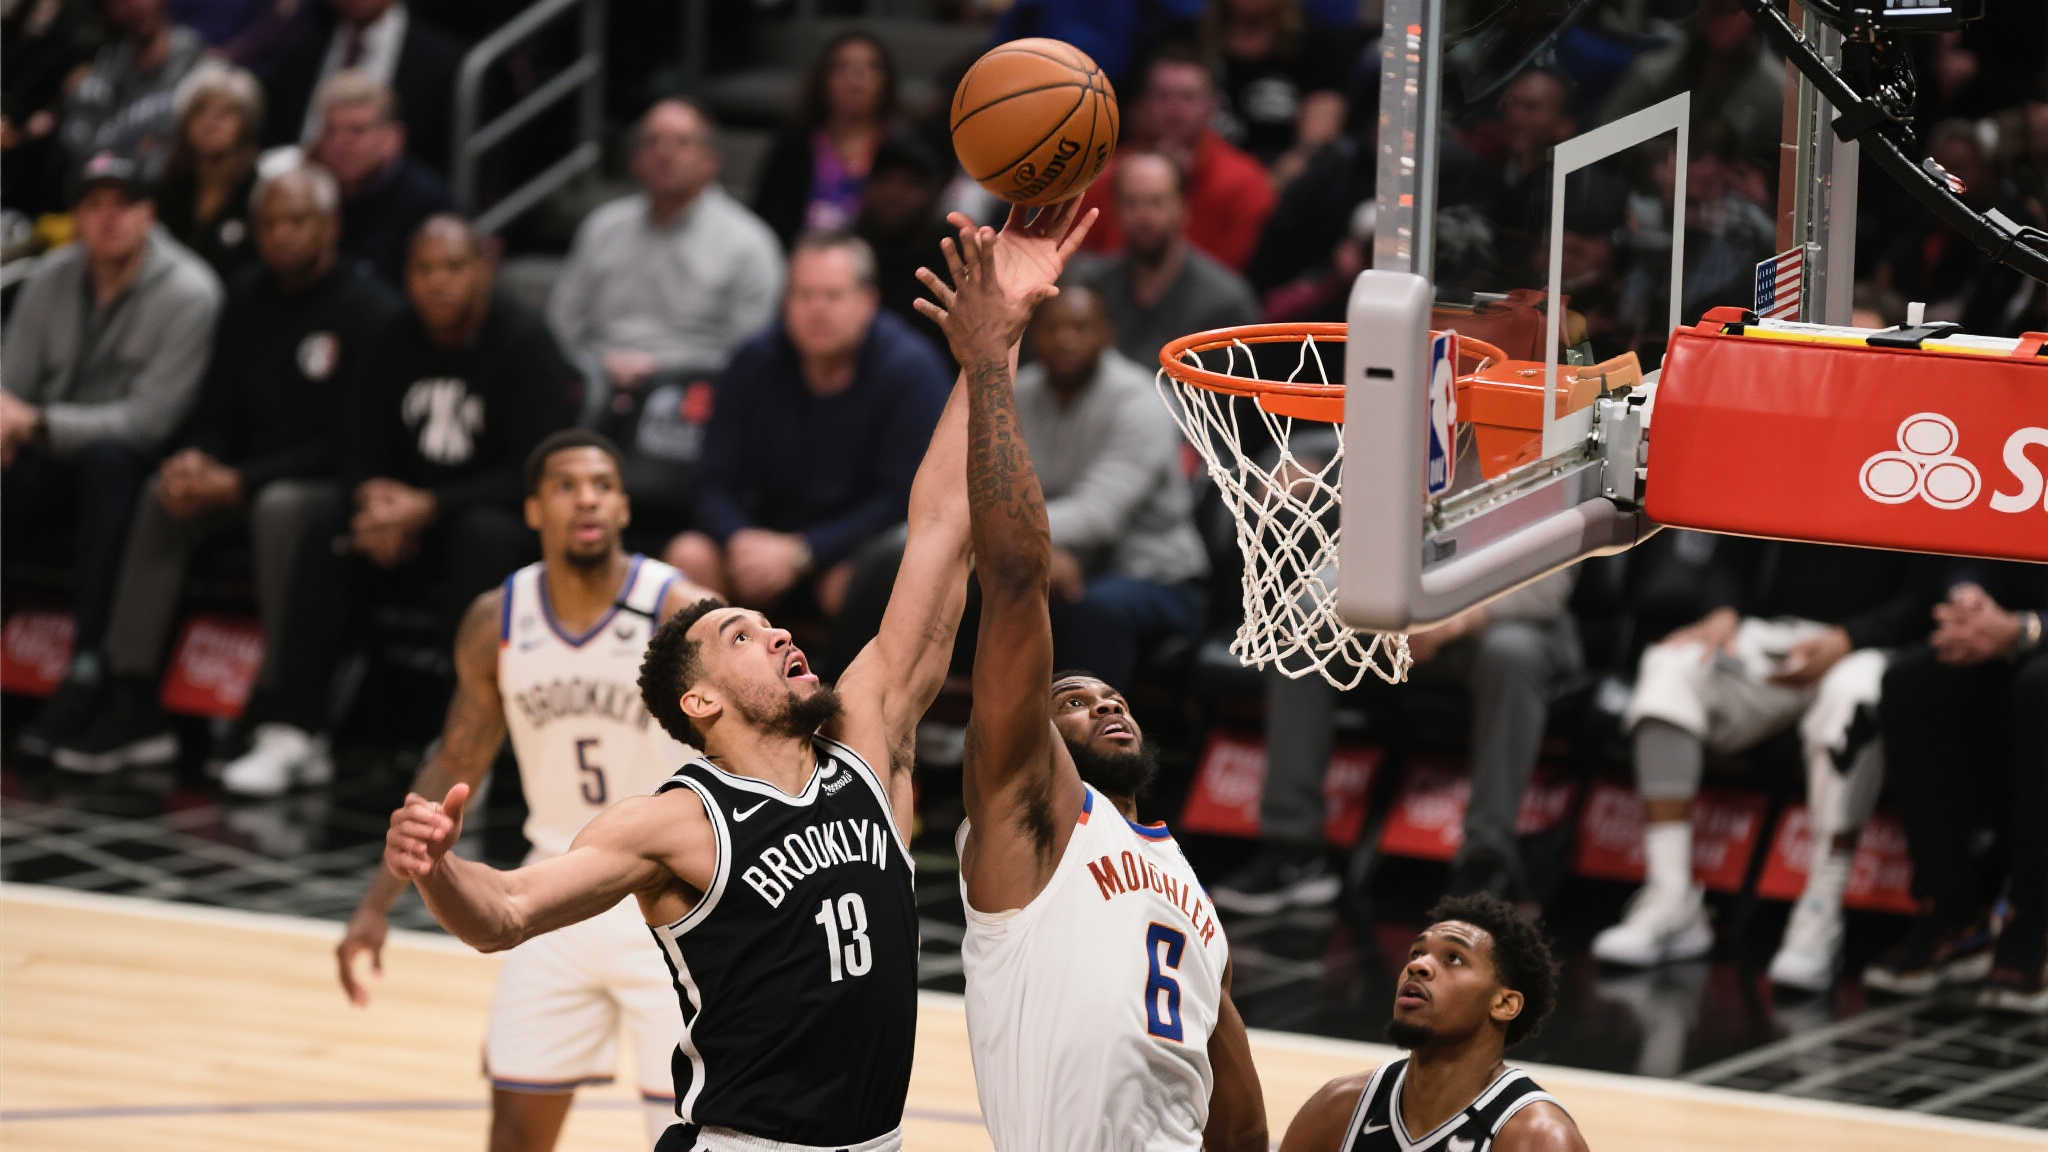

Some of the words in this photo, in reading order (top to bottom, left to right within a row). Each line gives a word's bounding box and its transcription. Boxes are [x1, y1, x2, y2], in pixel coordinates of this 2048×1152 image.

[575, 738, 607, 805] 5
[741, 818, 887, 909] BROOKLYN
[814, 892, 873, 983] 13
[1144, 920, 1187, 1044] 6
